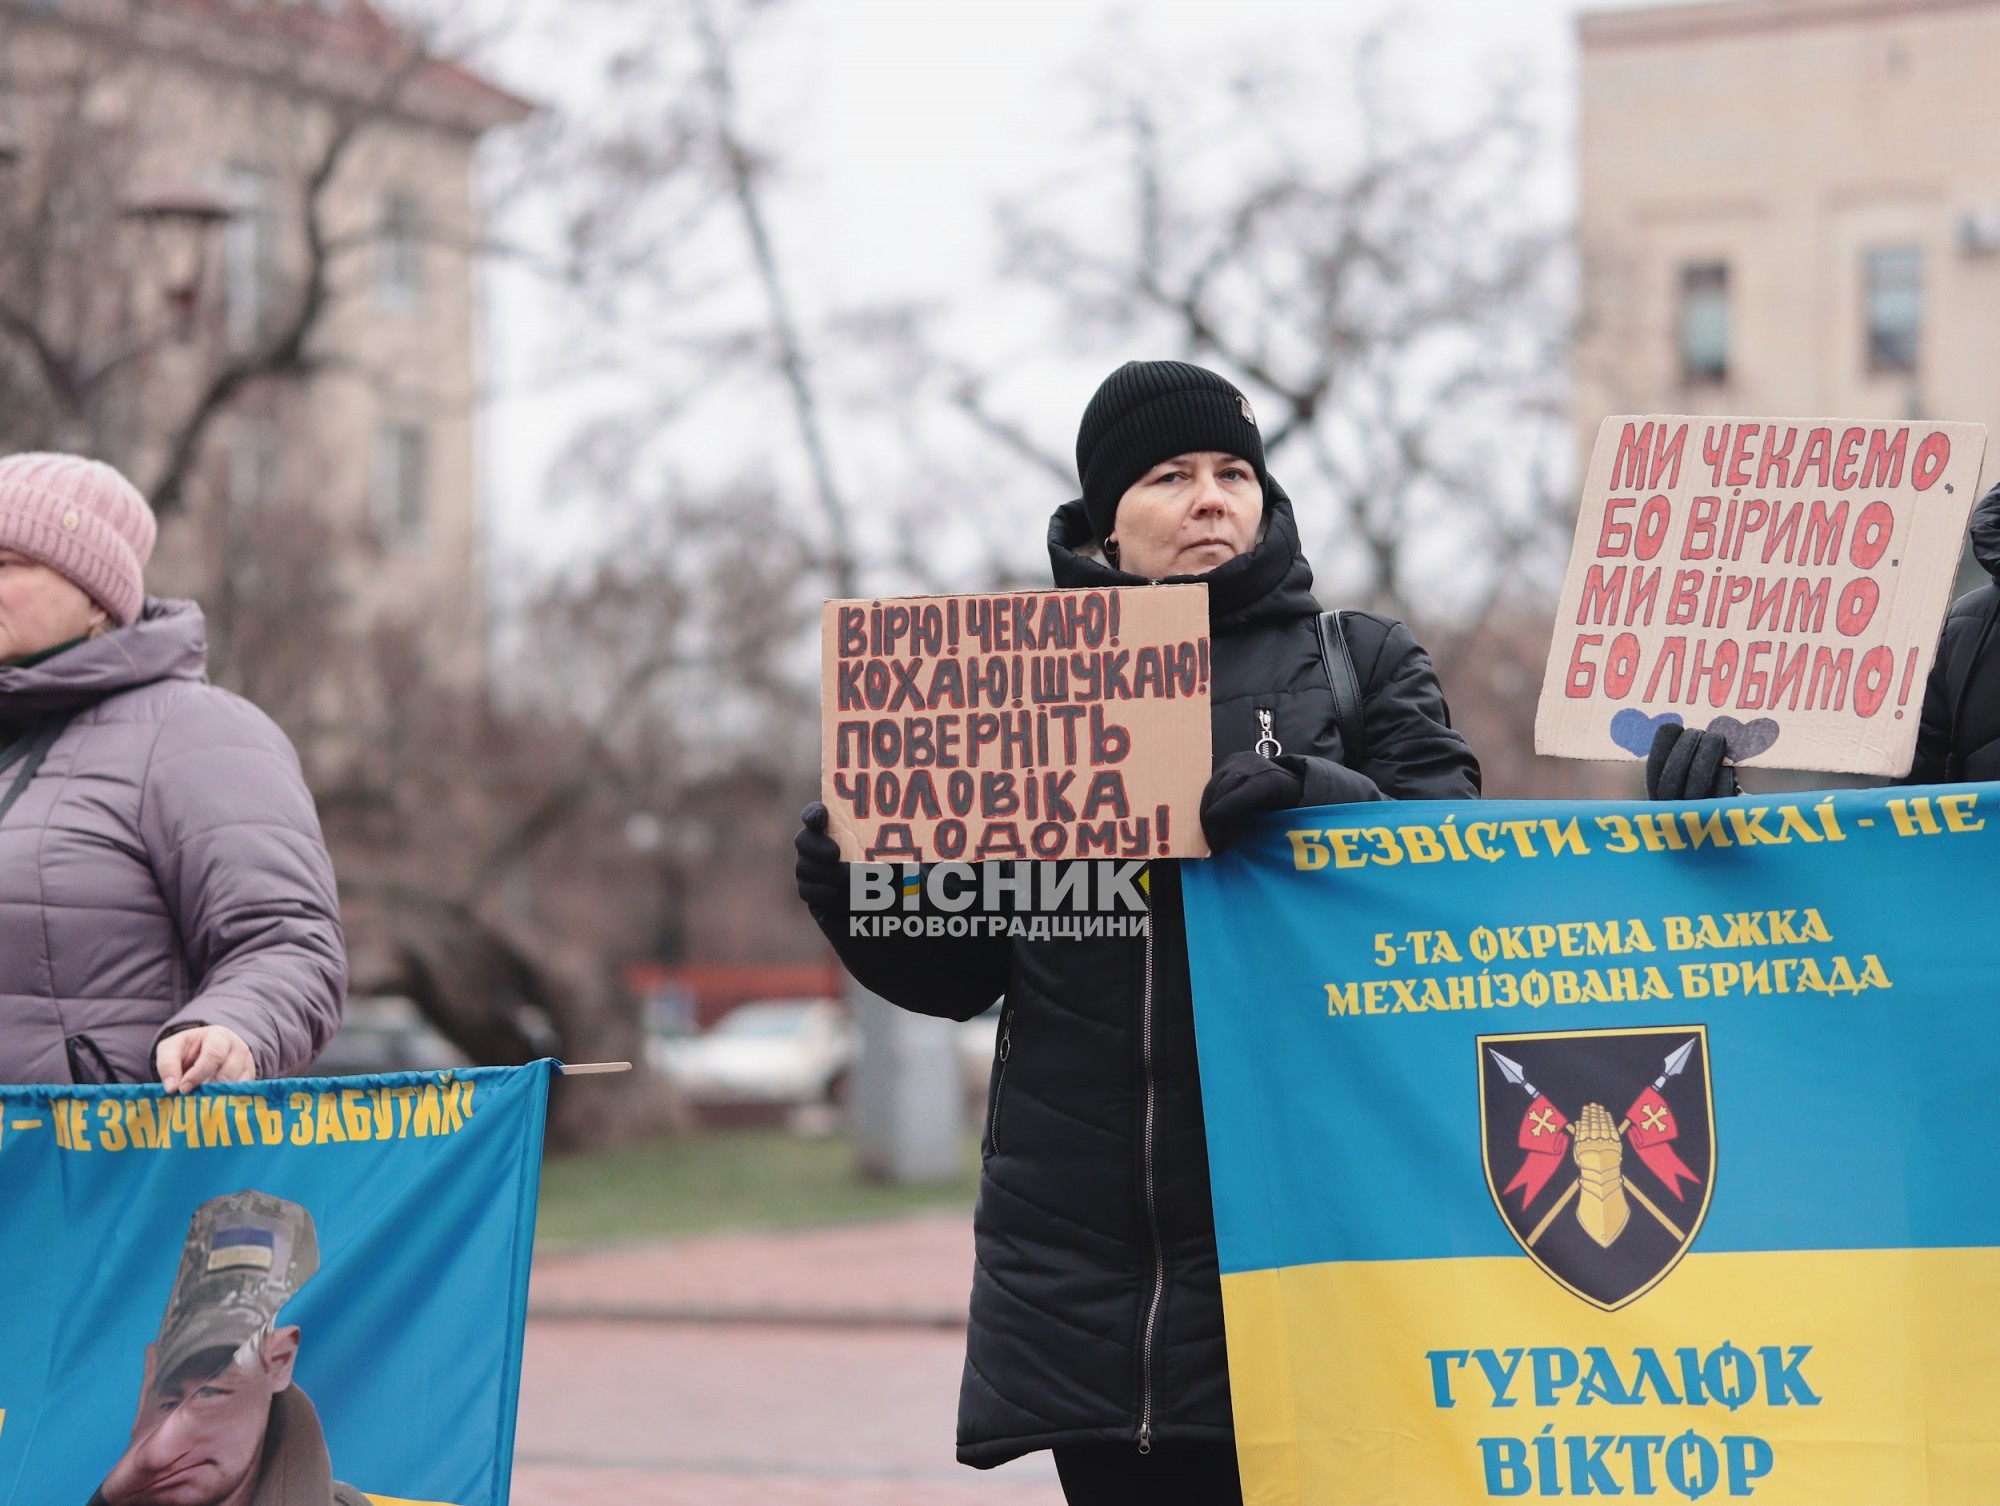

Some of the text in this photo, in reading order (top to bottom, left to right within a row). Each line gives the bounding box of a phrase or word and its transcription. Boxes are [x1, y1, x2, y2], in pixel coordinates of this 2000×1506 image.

[1610, 422, 1689, 491] МИ
[1596, 495, 1671, 561] БО
[838, 589, 1121, 658] ВІРЮ! ЧЕКАЮ!
[1576, 564, 1880, 637] МИ ВІРИМО
[837, 637, 1209, 712] КОХАЮ! ШУКАЮ!
[836, 703, 1131, 770] ПОВЕРНІТЬ
[833, 768, 1131, 823] ЧОЛОВІКА
[864, 805, 1170, 862] ДОДОМУ!
[1286, 814, 1592, 871] БЕЗВІСТИ
[1594, 796, 1846, 854] ЗНИКЛІ
[1885, 793, 1985, 836] НЕ
[1373, 907, 1834, 967] 5-ТА ОКРЕМА ВАЖКА
[1323, 953, 1893, 1018] МЕХАНІЗОВАНА БРИГАДА
[50, 1098, 92, 1151] НЕ
[97, 1094, 283, 1151] ЗНАЧИТЬ
[1425, 1339, 1823, 1413] ГУРАЛЮК
[1476, 1423, 1775, 1502] ВІКТОР
